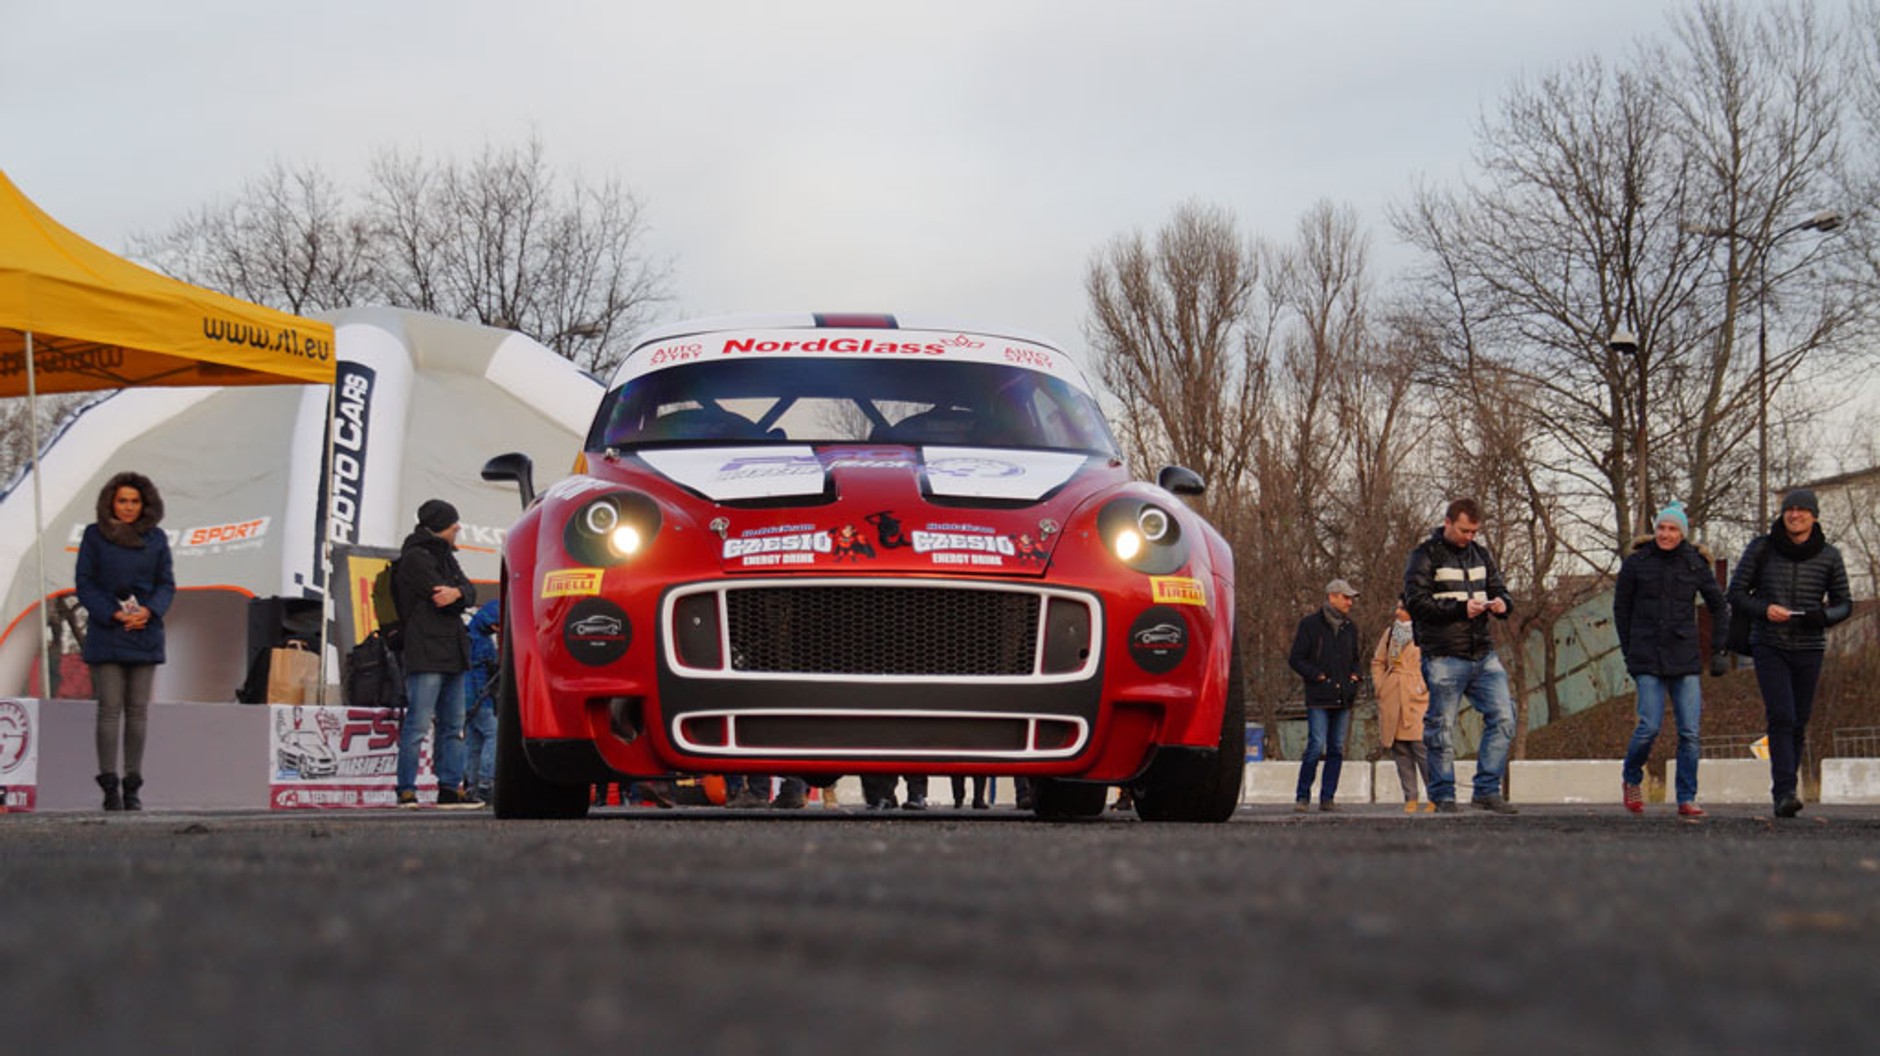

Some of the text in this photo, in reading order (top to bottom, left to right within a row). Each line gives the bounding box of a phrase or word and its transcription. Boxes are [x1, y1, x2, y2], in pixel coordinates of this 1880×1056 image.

[722, 338, 945, 355] NordGlass
[190, 519, 264, 545] SPORT
[743, 554, 780, 566] ENERGY
[932, 553, 969, 564] ENERGY
[546, 572, 597, 592] PIRELLI
[1157, 580, 1202, 600] PIRELLI
